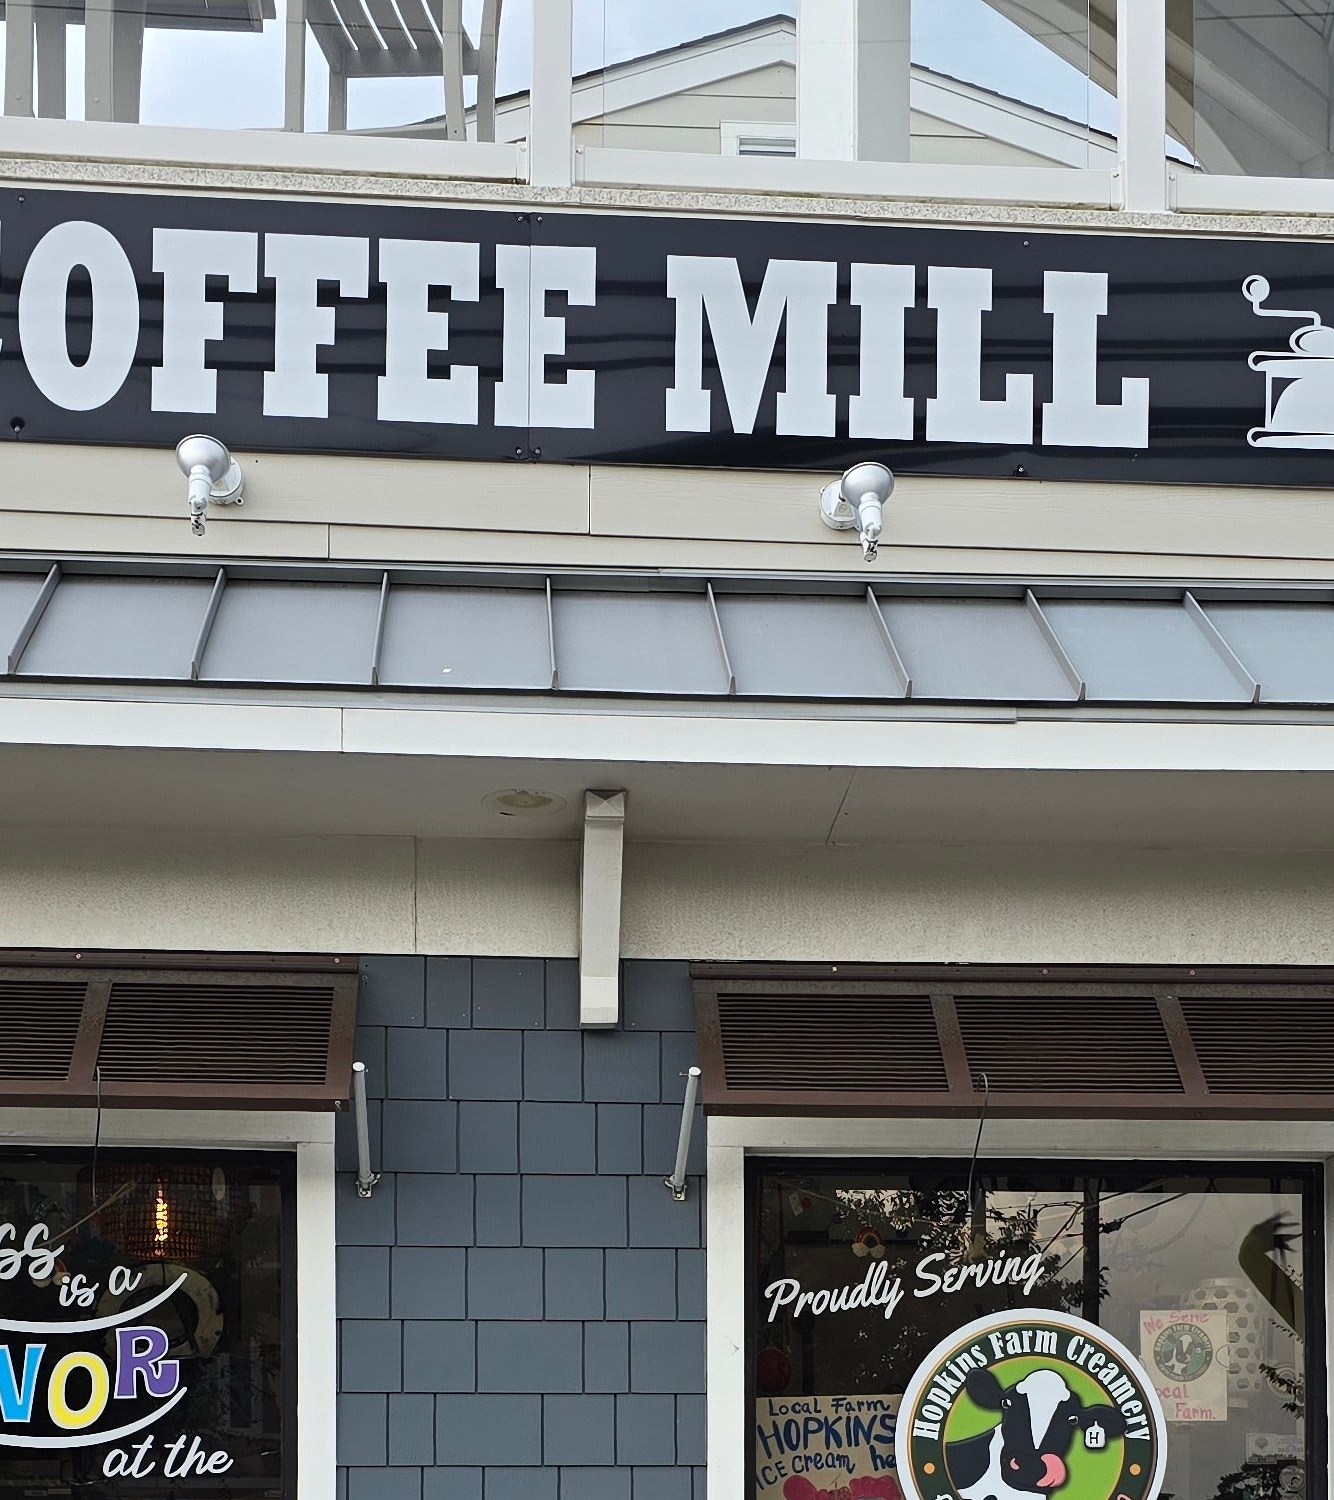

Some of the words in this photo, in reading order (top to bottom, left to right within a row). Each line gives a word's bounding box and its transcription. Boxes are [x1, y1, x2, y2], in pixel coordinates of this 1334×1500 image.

[665, 254, 1150, 449] MILL
[59, 1274, 99, 1307] is
[108, 1265, 143, 1295] a
[764, 1260, 904, 1323] Proudly
[913, 1249, 1046, 1300] Serving
[769, 1398, 822, 1416] Local
[831, 1397, 891, 1414] Farm
[913, 1343, 988, 1440] Hopkins
[988, 1329, 1058, 1359] Farm
[1067, 1335, 1151, 1441] Creamery
[1155, 1384, 1189, 1400] ocal
[103, 1435, 158, 1478] at
[161, 1436, 234, 1478] the
